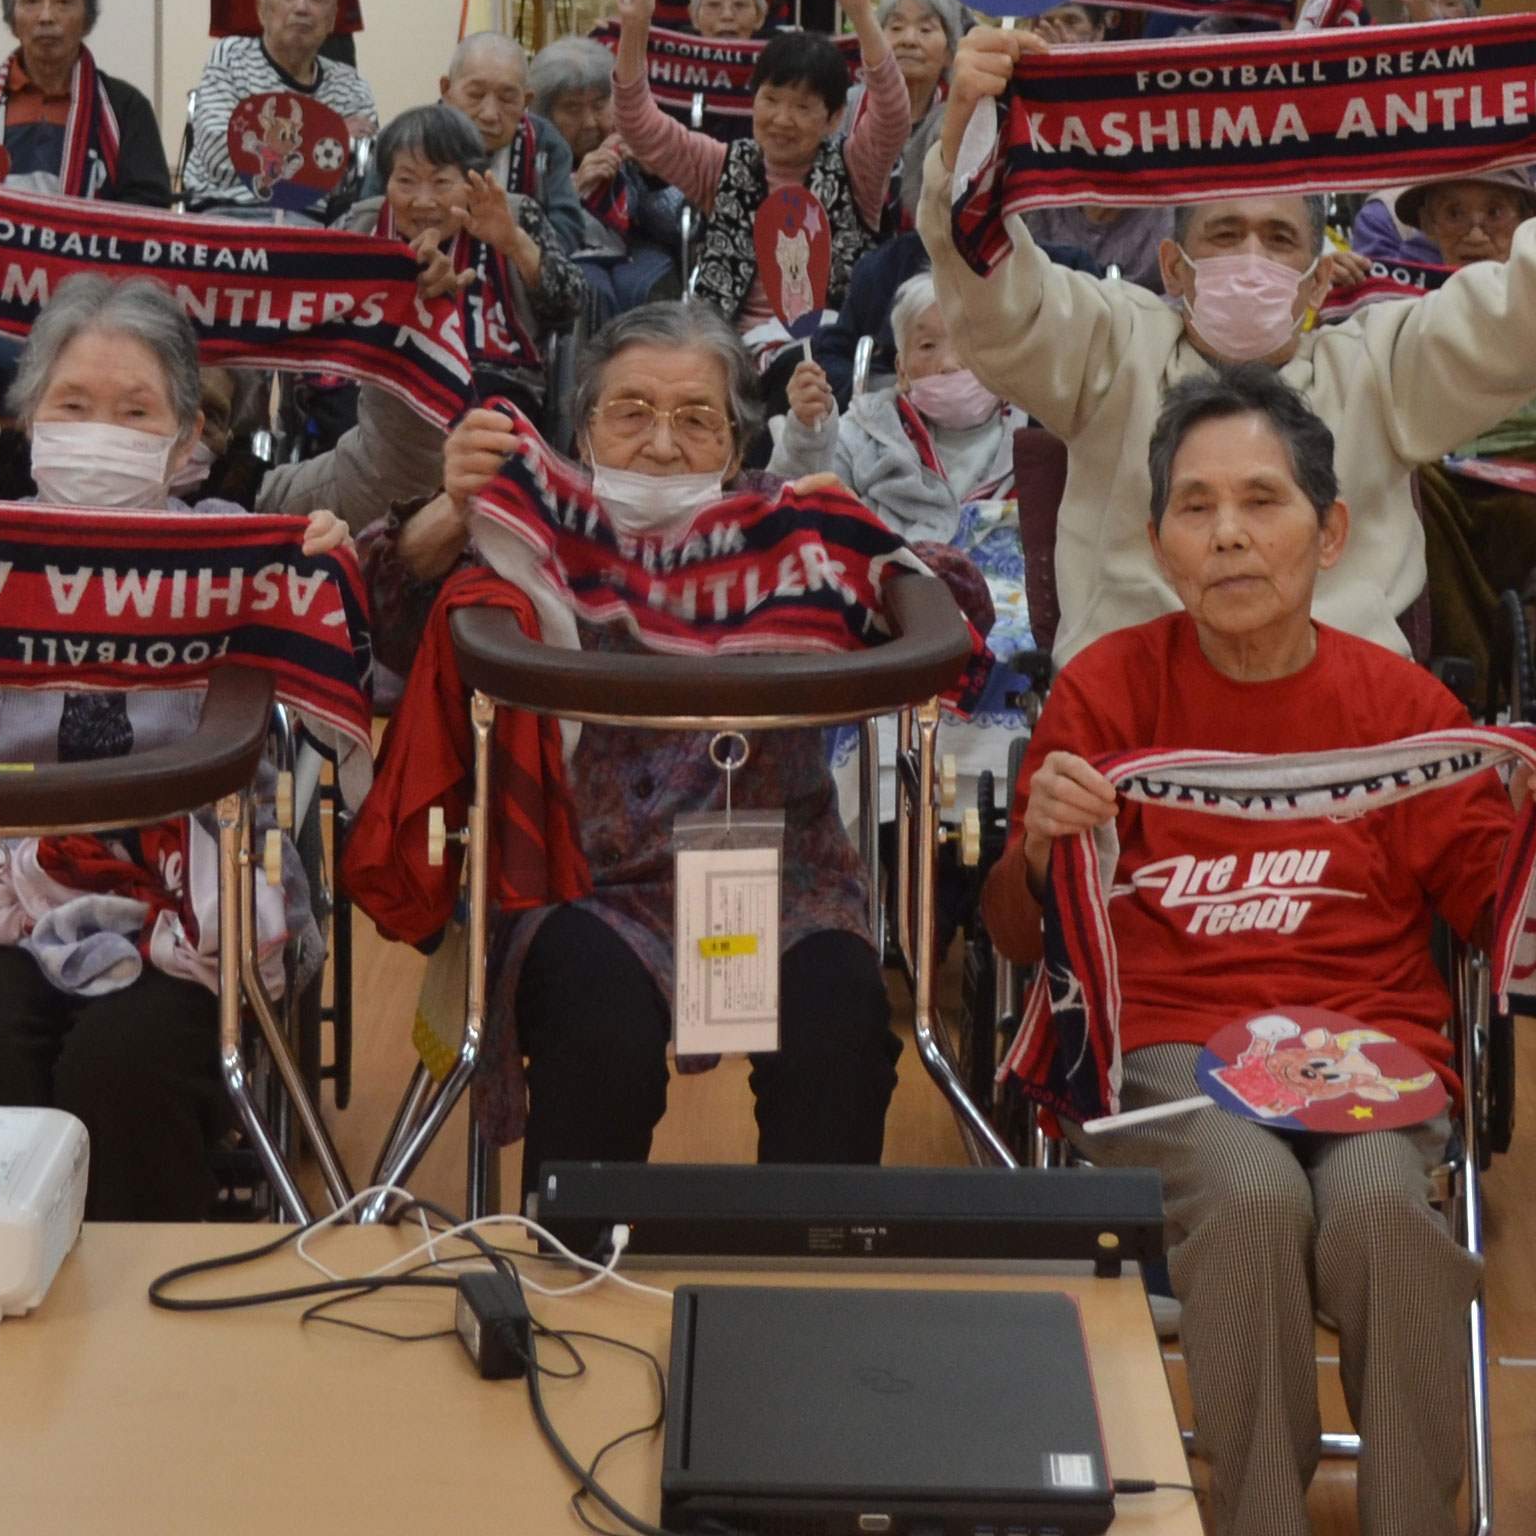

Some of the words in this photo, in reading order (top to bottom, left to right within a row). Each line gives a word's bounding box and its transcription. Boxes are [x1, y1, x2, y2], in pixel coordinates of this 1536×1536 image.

[650, 59, 732, 90] HIMA
[1136, 58, 1326, 92] FOOTBALL
[1347, 42, 1476, 80] DREAM
[1027, 102, 1309, 158] KASHIMA
[141, 238, 270, 272] DREAM
[175, 284, 389, 332] NTLERS
[17, 634, 231, 668] FOOTBALL
[1242, 848, 1331, 889] you
[1186, 895, 1312, 936] ready
